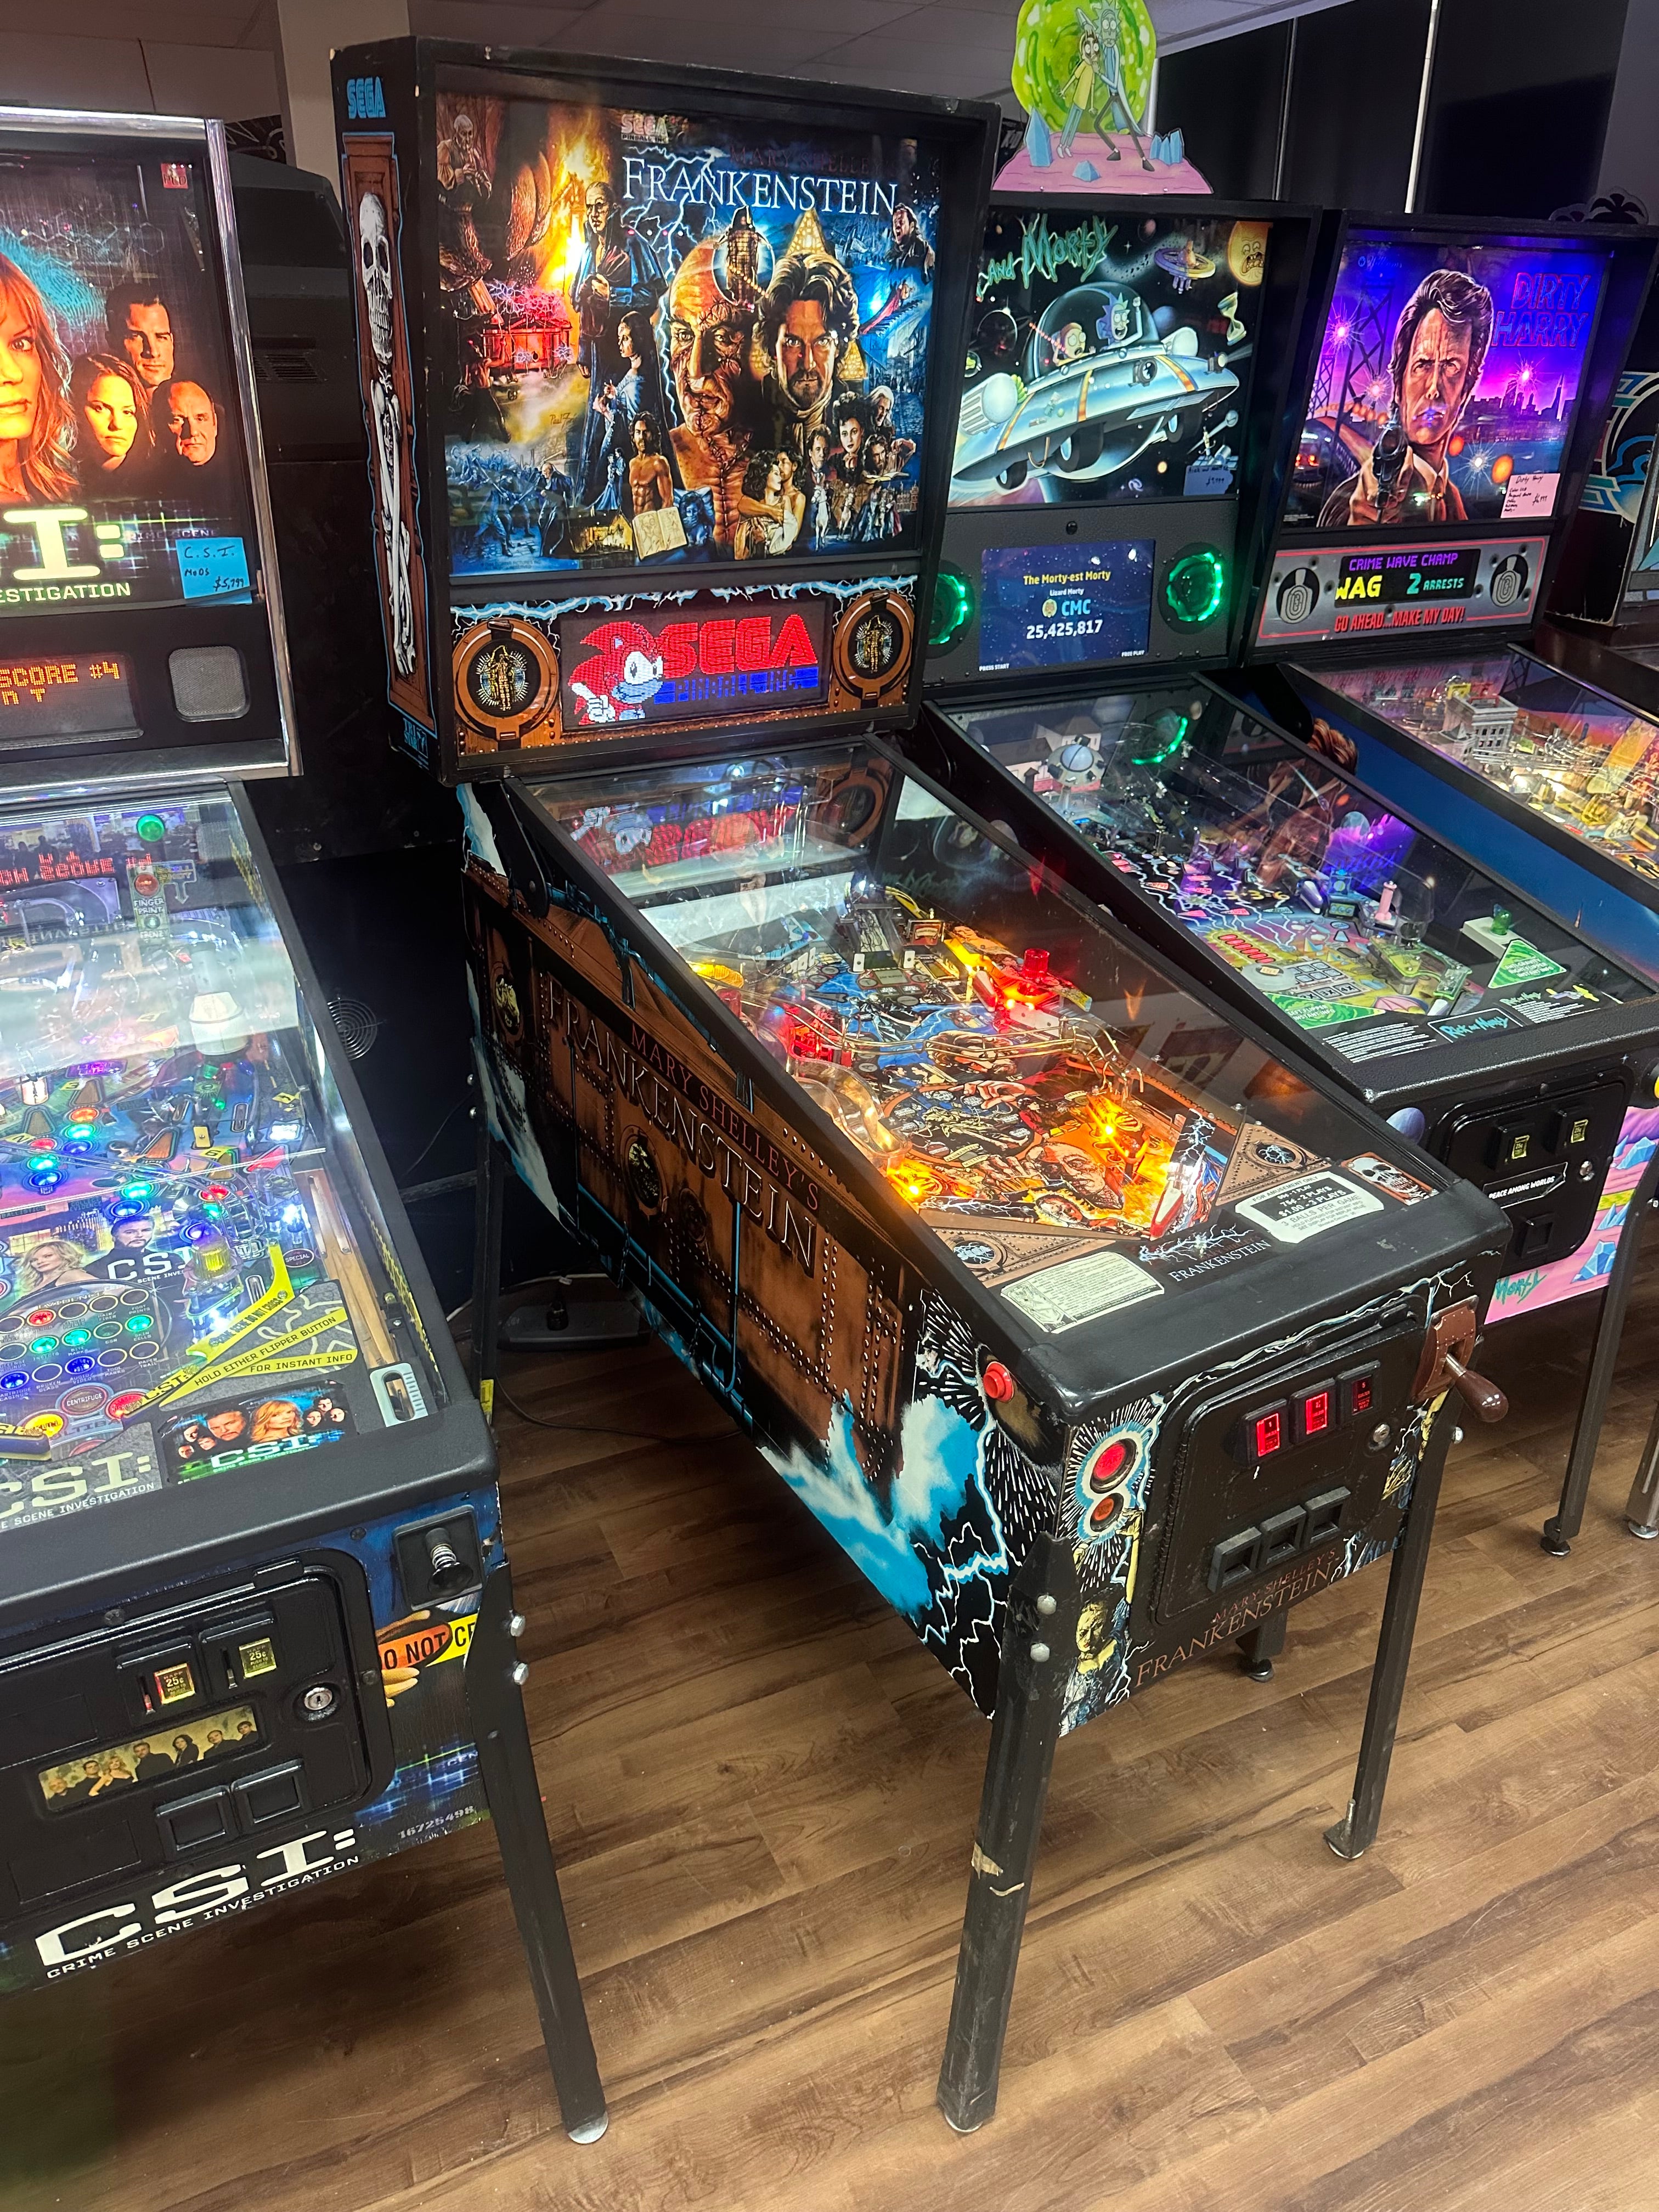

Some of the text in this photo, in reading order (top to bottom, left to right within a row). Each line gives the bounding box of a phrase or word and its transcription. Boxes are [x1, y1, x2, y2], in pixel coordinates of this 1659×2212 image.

[347, 76, 386, 119] SEGA
[621, 114, 668, 137] SEGA
[622, 157, 898, 215] FRANKENSTEIN
[1511, 273, 1591, 310] DIRTY
[1491, 311, 1589, 347] HARRY
[1349, 552, 1459, 571] CRIME WAVE CHAMP
[1023, 571, 1111, 585] The Morty-est Morty
[1406, 573, 1421, 595] 2
[1423, 578, 1465, 591] ARRESTS
[1061, 599, 1091, 616] CMC
[1334, 606, 1466, 632] GO MY DAY!
[1026, 619, 1103, 640] 25,425,817
[658, 613, 818, 679] SEGA
[0, 661, 120, 688] SCORE #4
[133, 898, 164, 907] FINGER
[138, 906, 163, 916] PRINT
[1302, 1004, 1328, 1014] FLIPPER
[549, 980, 817, 1279] FRANKENSTEIN
[631, 1024, 820, 1211] MARY SHELLEY'S
[1252, 1176, 1318, 1202] FOR AMUSEMENT ONLY
[1296, 1184, 1312, 1193] PLAY
[1306, 1186, 1333, 1198] PLAYS
[1488, 1175, 1556, 1199] PEACE AMONG WORLDS
[2, 1206, 45, 1218] BALLISTICS
[1278, 1204, 1305, 1217] $1.00
[1318, 1190, 1347, 1203] PLAYS
[1290, 1210, 1317, 1223] BALLS
[1319, 1203, 1335, 1212] PER
[1338, 1194, 1362, 1205] GAME
[285, 1253, 311, 1263] SPECIAL
[1168, 1239, 1272, 1282] FRANKENSTEIN
[137, 1275, 161, 1284] SCENE
[262, 1297, 284, 1311] CROSS
[194, 1316, 337, 1386] HOLD EITHER FLIPPER BUTTON
[250, 1353, 353, 1373] FOR INSTANT INFO
[66, 1393, 103, 1407] CENTRIFUGE
[144, 1374, 190, 1401] CSI:
[211, 1434, 318, 1469] CSI:
[14, 1481, 155, 1526] SCENE INVESTIGATION
[1214, 1548, 1336, 1621] MARY SHELLEY'S
[1135, 1561, 1333, 1688] FRANKENSTEIN
[249, 1650, 267, 1662] 25¢
[405, 1632, 447, 1664] NOT
[166, 1676, 184, 1688] 25¢
[397, 1805, 476, 1839] 16725498
[35, 1828, 357, 1967] CSI:
[47, 1855, 360, 1979] CRIME SCENE INVESTIGATION
